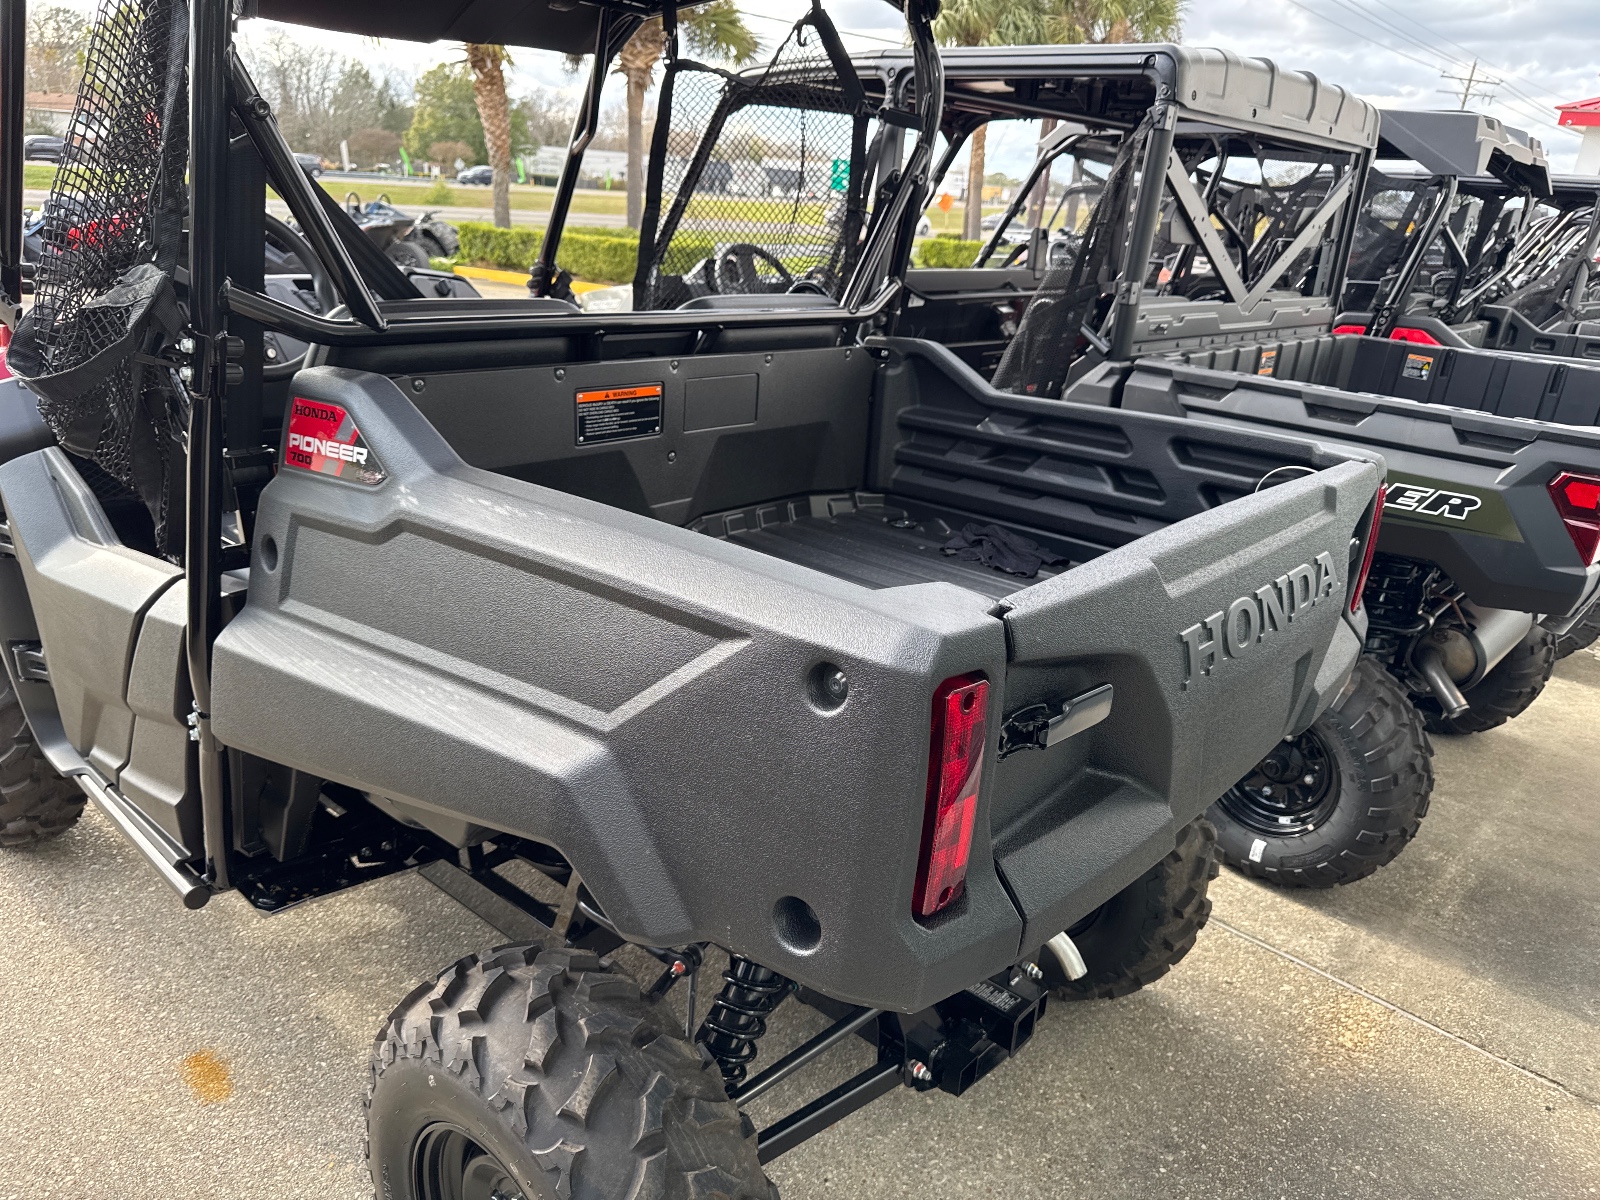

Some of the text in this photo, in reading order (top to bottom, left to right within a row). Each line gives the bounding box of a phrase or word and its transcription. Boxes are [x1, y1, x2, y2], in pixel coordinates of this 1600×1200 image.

[612, 390, 637, 398] WARNING
[294, 404, 338, 423] HONDA
[288, 432, 369, 465] PIONEER
[290, 451, 313, 466] 700
[1179, 551, 1341, 691] HONDA
